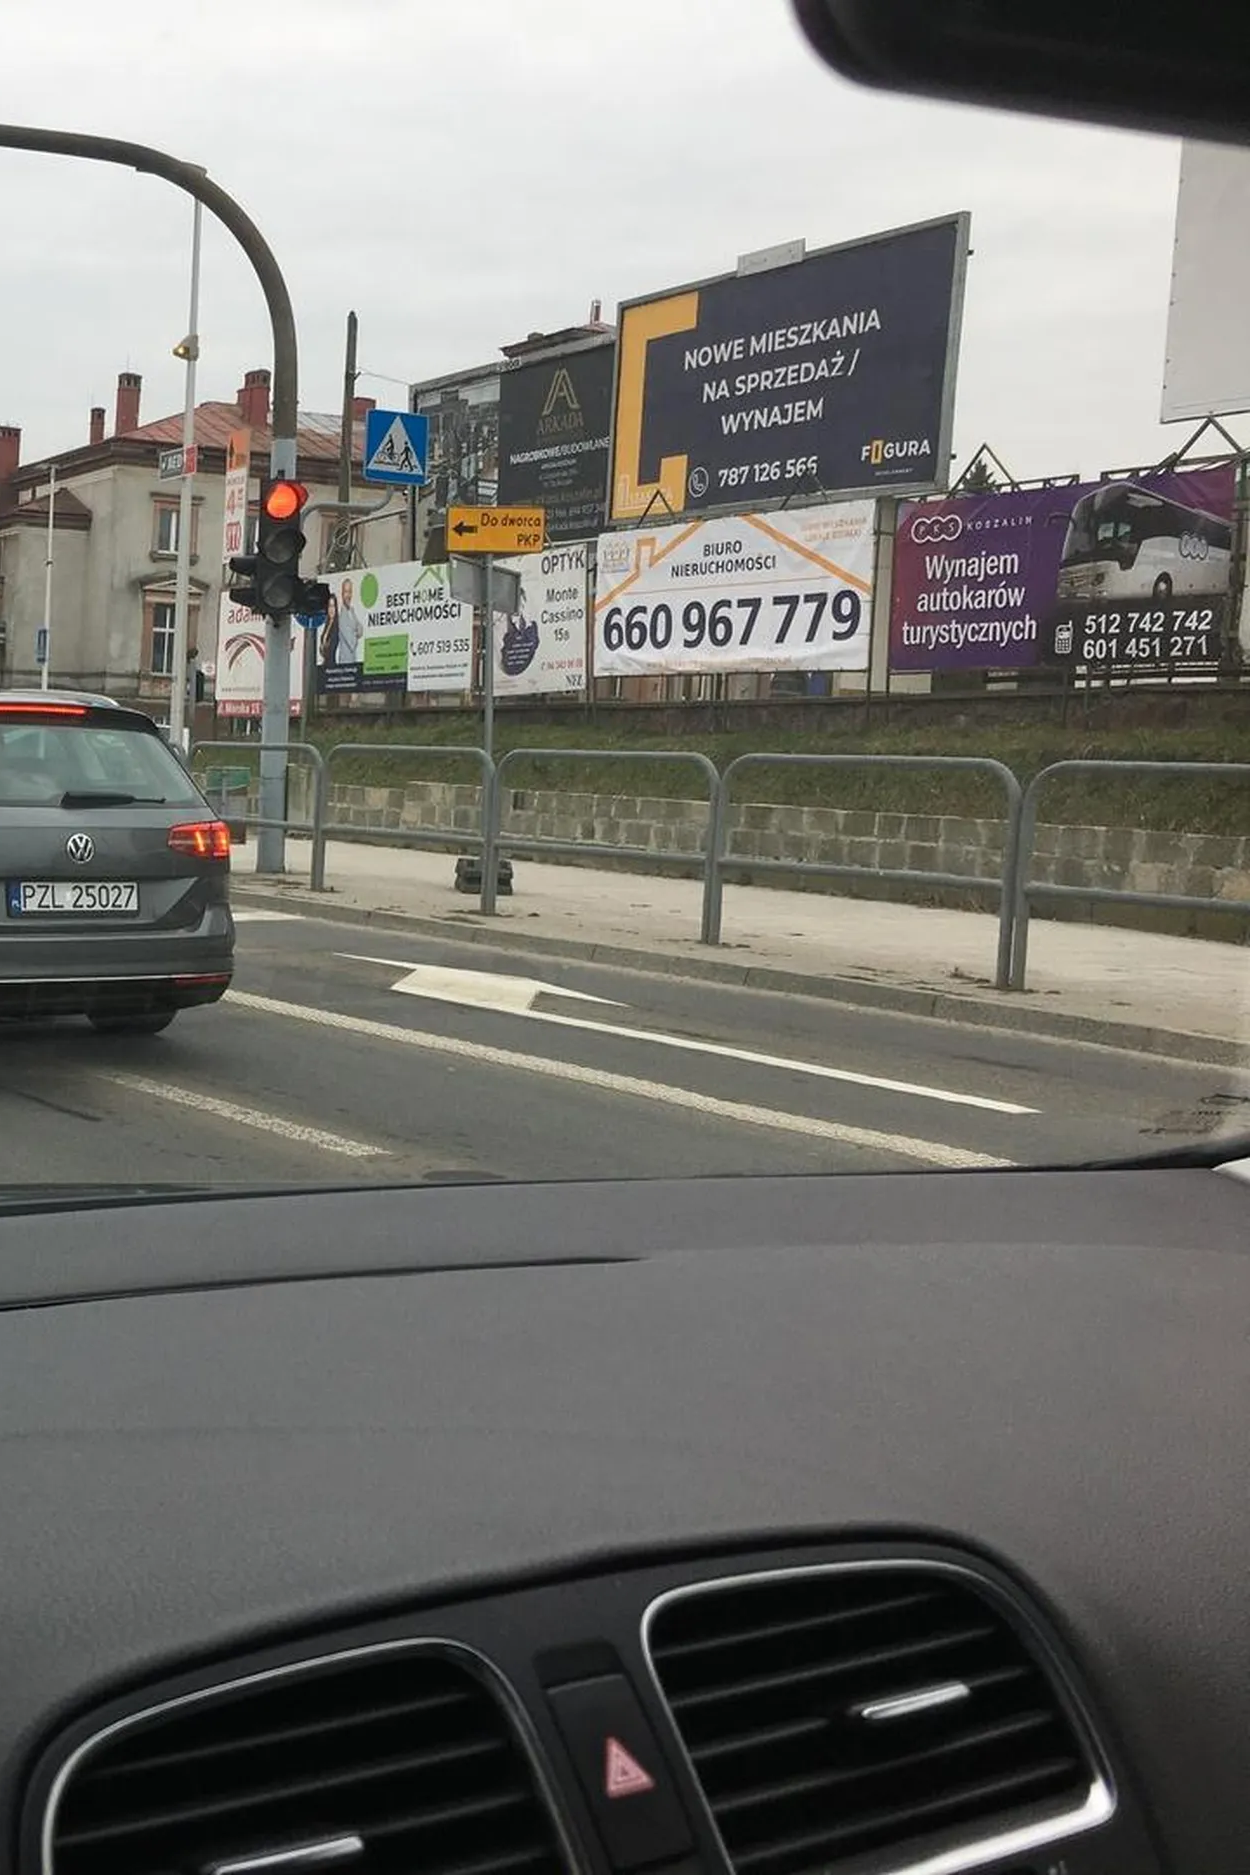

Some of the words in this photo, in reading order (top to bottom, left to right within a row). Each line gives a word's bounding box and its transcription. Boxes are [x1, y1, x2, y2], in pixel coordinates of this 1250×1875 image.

[684, 338, 745, 371] NOWE
[749, 308, 882, 356] MIESZKANIA
[702, 379, 730, 403] NA
[734, 350, 845, 397] SPRZEDAŻ
[721, 397, 824, 436] WYNAJEM
[717, 464, 749, 488] 787
[753, 461, 781, 482] 126
[784, 455, 819, 478] 566
[481, 513, 499, 527] Do
[501, 514, 541, 527] dworca
[966, 515, 1033, 532] KOSZALIN
[516, 533, 541, 547] PKP
[703, 540, 743, 557] BIURO
[541, 550, 585, 575] OPTYK
[670, 553, 777, 578] NIERUCHOMOŚCI
[925, 550, 1019, 584] Wynajem
[386, 591, 411, 608] BEST
[412, 586, 444, 604] HOME
[545, 587, 578, 602] Monte
[916, 580, 1026, 612] autokarów
[367, 599, 462, 627] NIERUCHOMOŚCI
[541, 608, 584, 624] Cassino
[603, 603, 673, 651] 660
[682, 597, 762, 649] 967
[772, 589, 862, 644] 779
[1084, 613, 1121, 635] 512
[1126, 611, 1166, 633] 742
[1172, 609, 1213, 632] 742
[902, 613, 1037, 650] turystycznych
[417, 641, 435, 656] 607
[436, 640, 451, 654] 519
[452, 638, 470, 652] 535
[1082, 638, 1118, 660] 601
[1124, 637, 1161, 658] 451
[1169, 634, 1208, 656] 271
[22, 884, 65, 909] PZL
[71, 884, 135, 909] 25027
